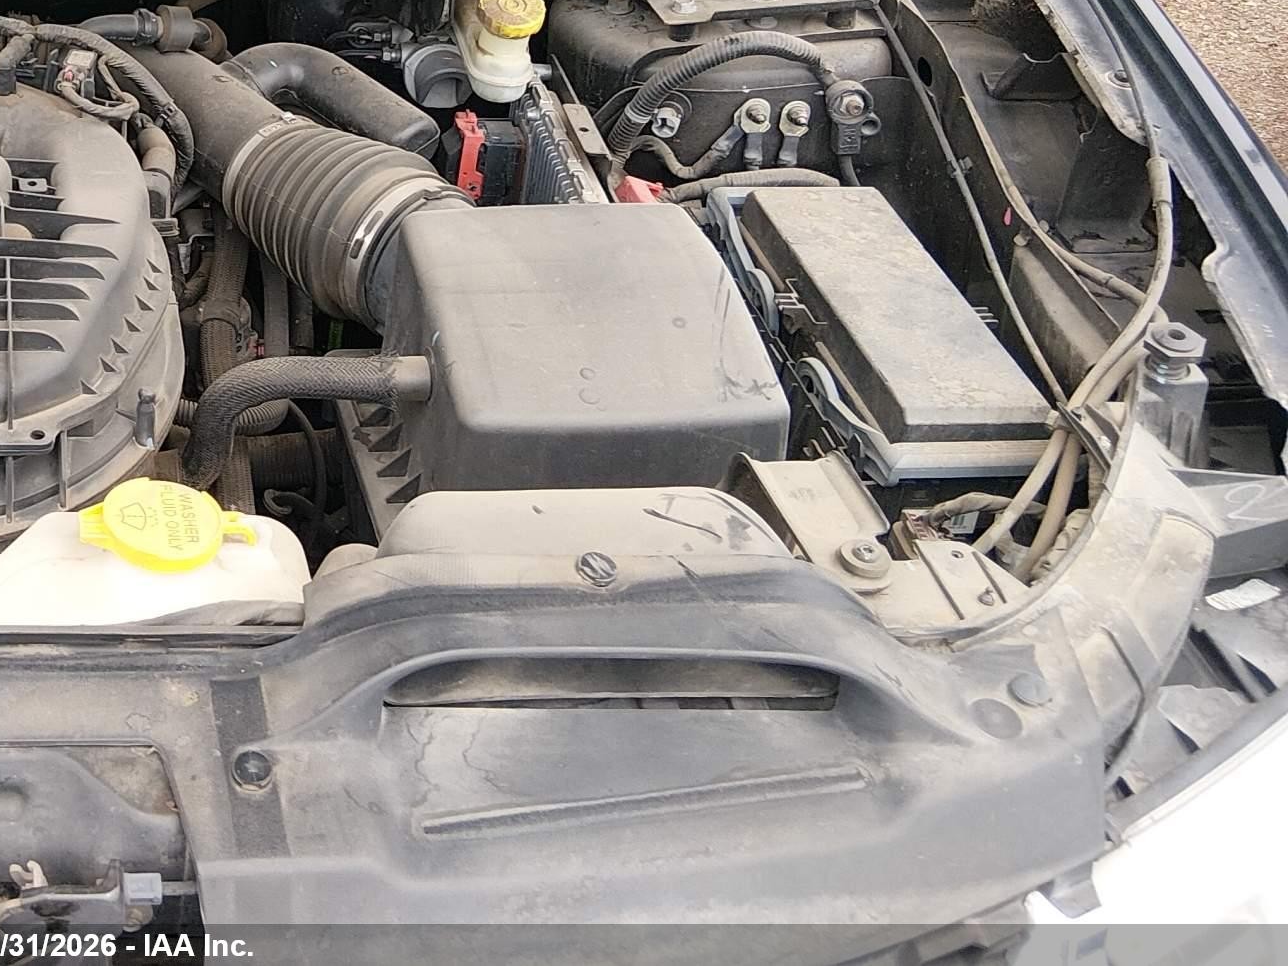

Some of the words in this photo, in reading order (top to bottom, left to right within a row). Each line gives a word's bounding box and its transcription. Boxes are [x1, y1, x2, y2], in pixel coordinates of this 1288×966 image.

[159, 484, 177, 518] FLUID
[178, 493, 200, 544] WASHER
[165, 520, 184, 552] ONLY
